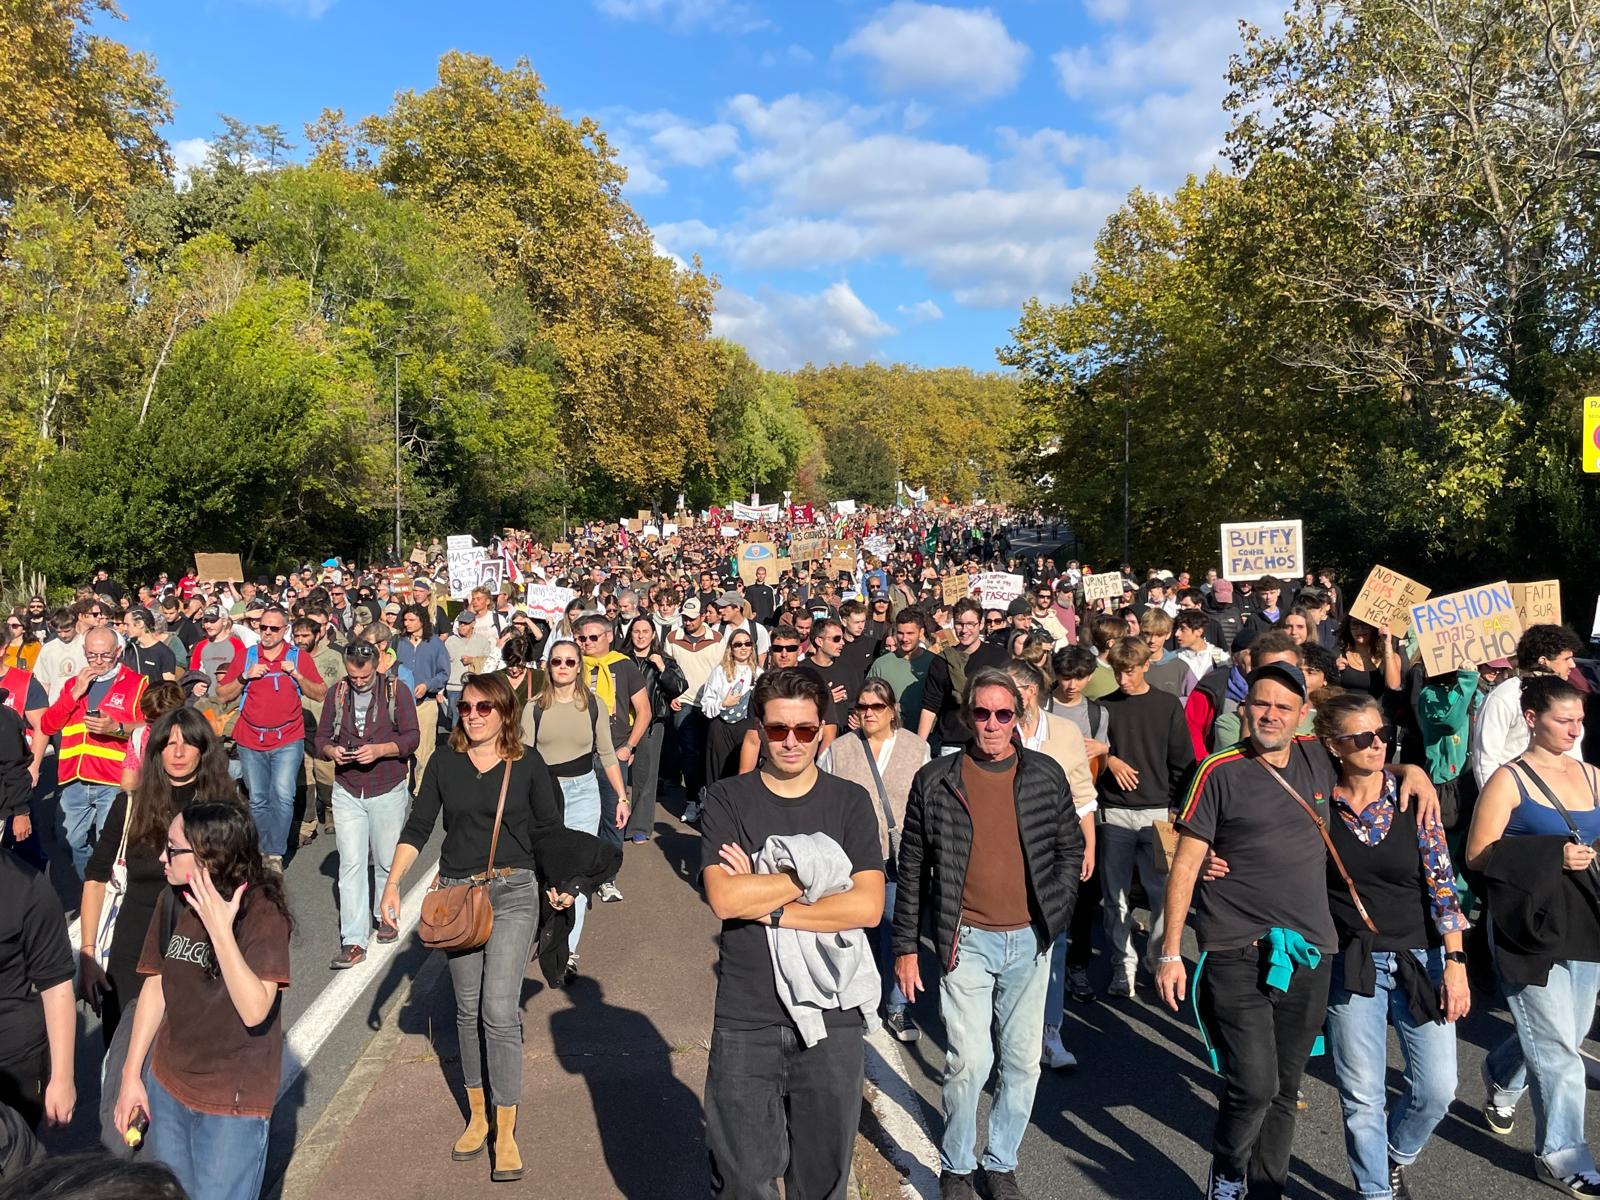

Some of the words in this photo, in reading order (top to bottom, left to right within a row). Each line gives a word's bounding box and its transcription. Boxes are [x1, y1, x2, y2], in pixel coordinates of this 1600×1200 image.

[1230, 528, 1293, 547] BUFFY
[448, 551, 484, 565] HASTA
[1231, 555, 1296, 573] FACHOS
[1085, 575, 1108, 587] URINE
[1374, 568, 1402, 586] NOT
[1368, 579, 1394, 598] COPS
[1524, 584, 1556, 602] FAIT
[1360, 589, 1371, 600] A
[1373, 596, 1395, 613] LOT
[1412, 586, 1512, 634] FASHION
[1533, 603, 1554, 617] SUR
[1436, 624, 1475, 645] mais
[1483, 615, 1514, 635] PAS
[1432, 631, 1518, 673] FACHO
